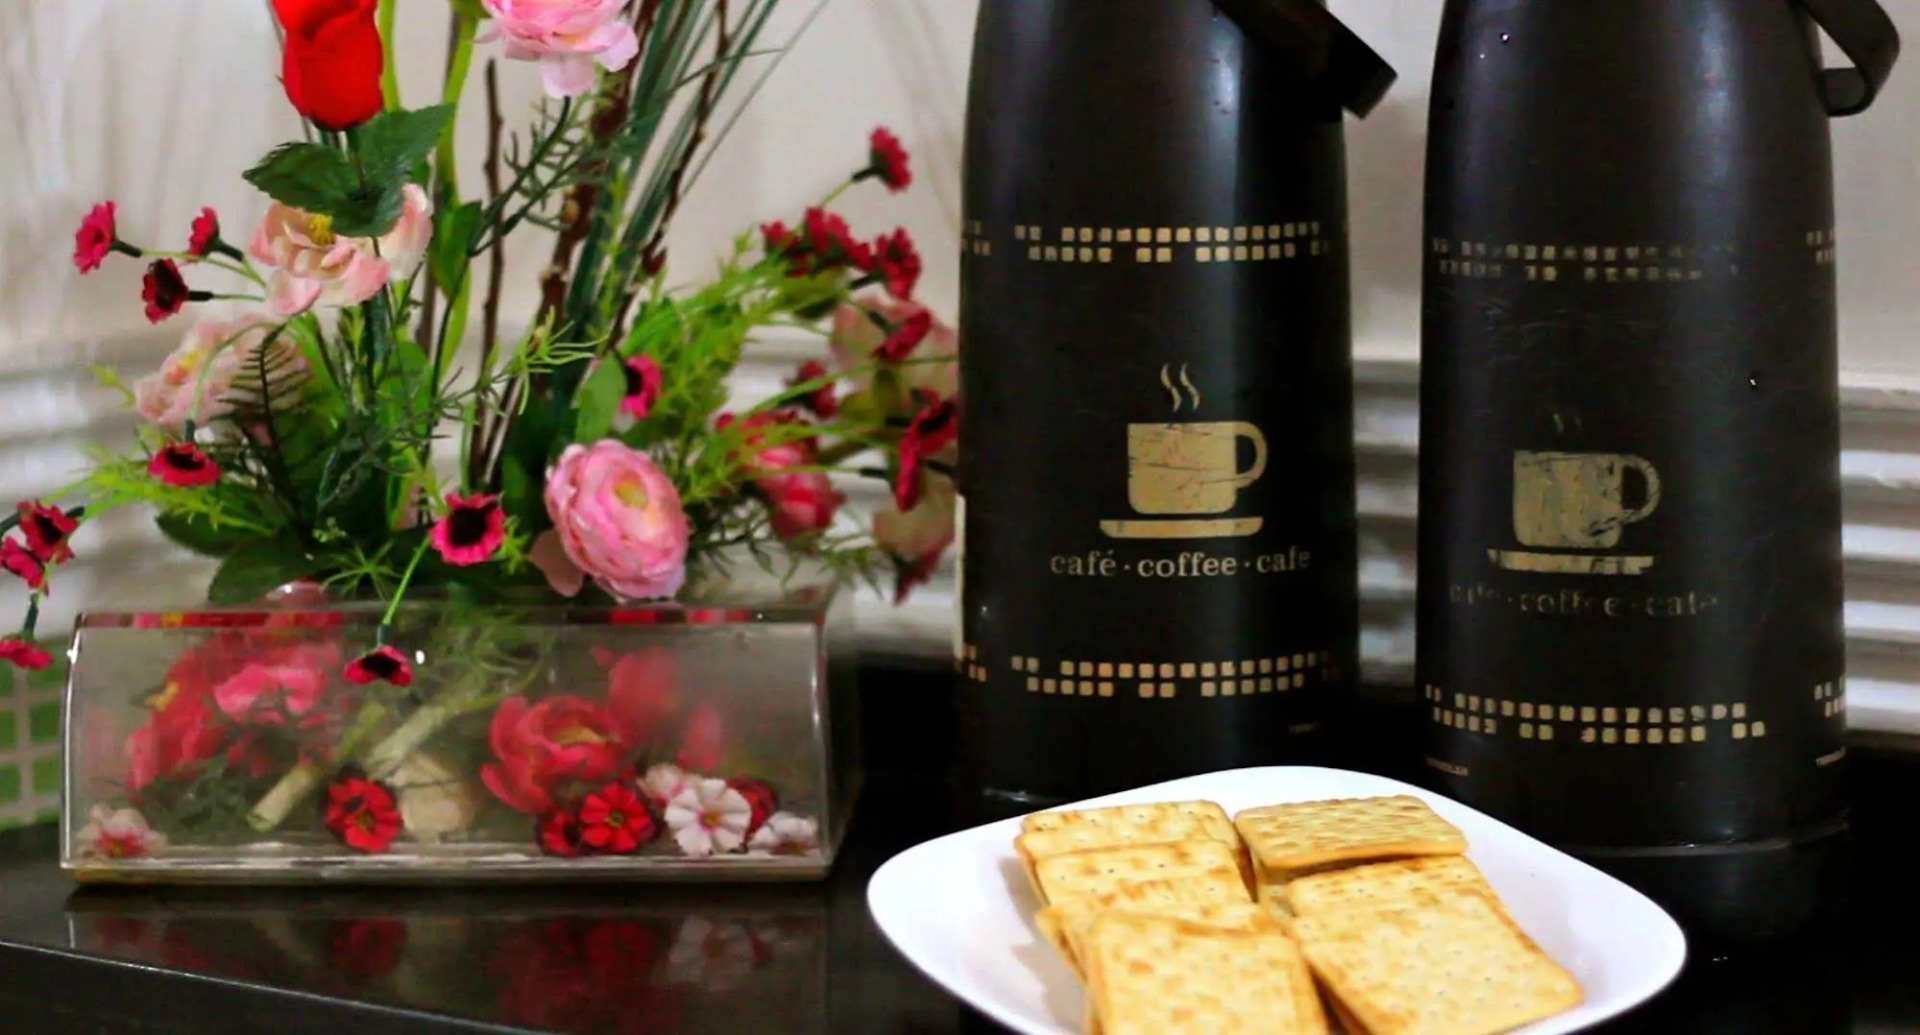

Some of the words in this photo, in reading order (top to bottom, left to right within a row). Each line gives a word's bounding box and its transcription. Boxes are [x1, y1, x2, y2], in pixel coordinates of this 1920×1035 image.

[1050, 550, 1116, 576] café
[1137, 552, 1237, 577] coffee
[1520, 588, 1621, 616] coffe
